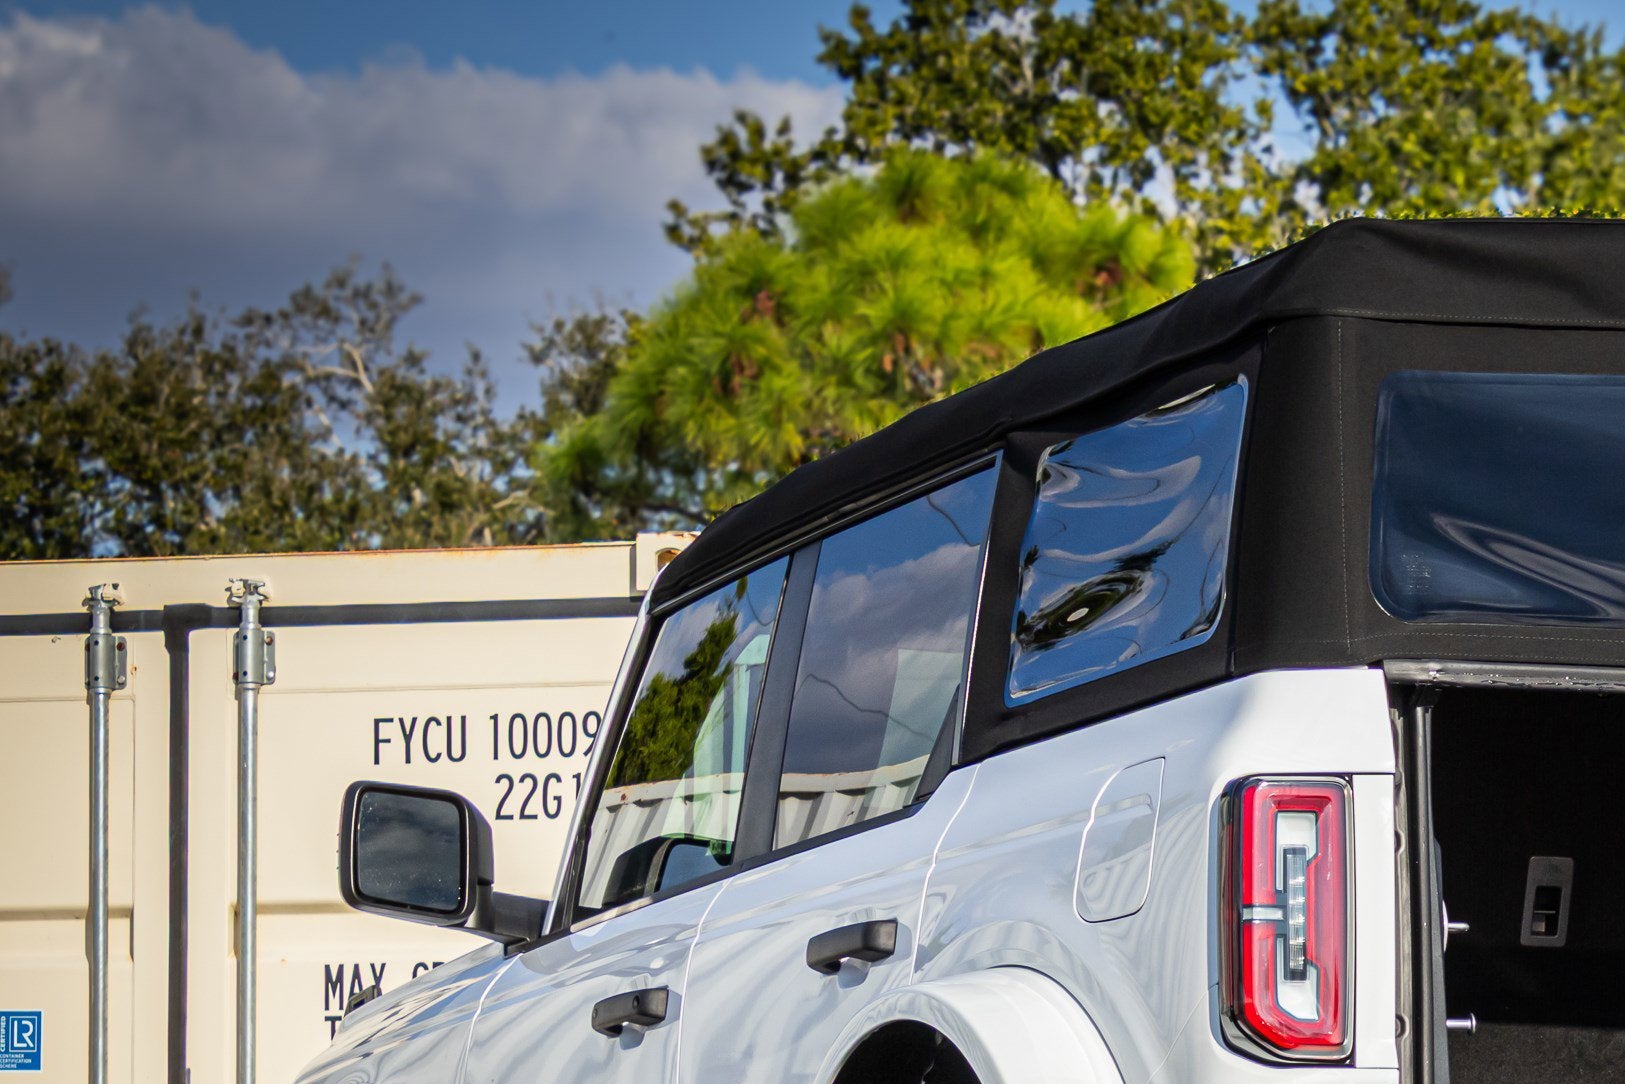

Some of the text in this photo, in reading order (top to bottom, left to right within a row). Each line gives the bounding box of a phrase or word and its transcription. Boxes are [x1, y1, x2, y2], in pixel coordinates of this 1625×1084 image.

[373, 711, 602, 765] FYCU 10009
[13, 1020, 34, 1047] LR
